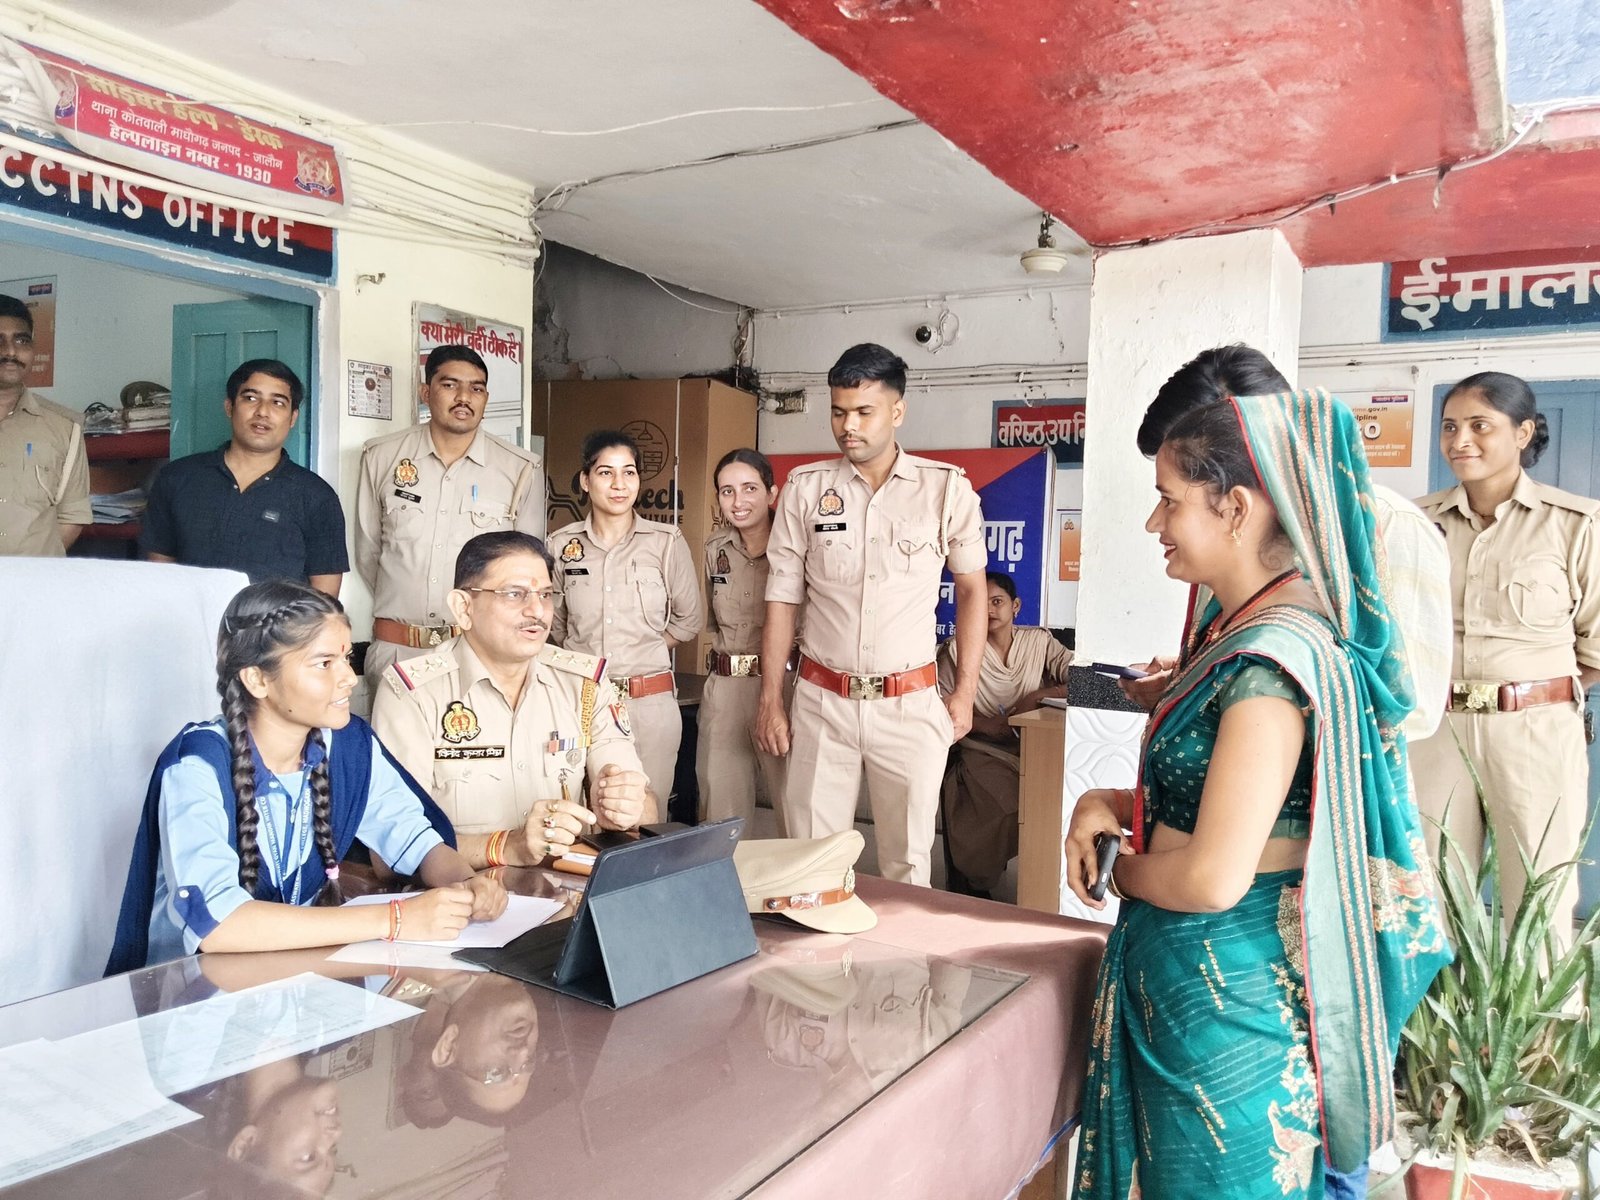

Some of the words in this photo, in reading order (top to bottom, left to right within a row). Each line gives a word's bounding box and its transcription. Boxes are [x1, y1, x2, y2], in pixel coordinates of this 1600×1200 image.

[91, 100, 118, 119] थाना
[121, 107, 168, 134] कोतवाली
[170, 126, 209, 150] माधौगढ़
[212, 139, 241, 158] जनपद
[252, 150, 283, 170] जालौन
[108, 119, 182, 158] हेल्पलाइन
[185, 147, 220, 169] नम्बर
[236, 162, 272, 184] 1930
[234, 114, 283, 150] डेस्क
[0, 149, 143, 220] CCTNS
[162, 194, 295, 256] OFFICE
[1400, 257, 1600, 331] ई-माल
[420, 321, 443, 342] क्या
[443, 318, 466, 346] मेरी
[465, 326, 488, 357] वर्दी
[998, 413, 1046, 448] वरिष्ठ
[983, 520, 1026, 573] गढ़
